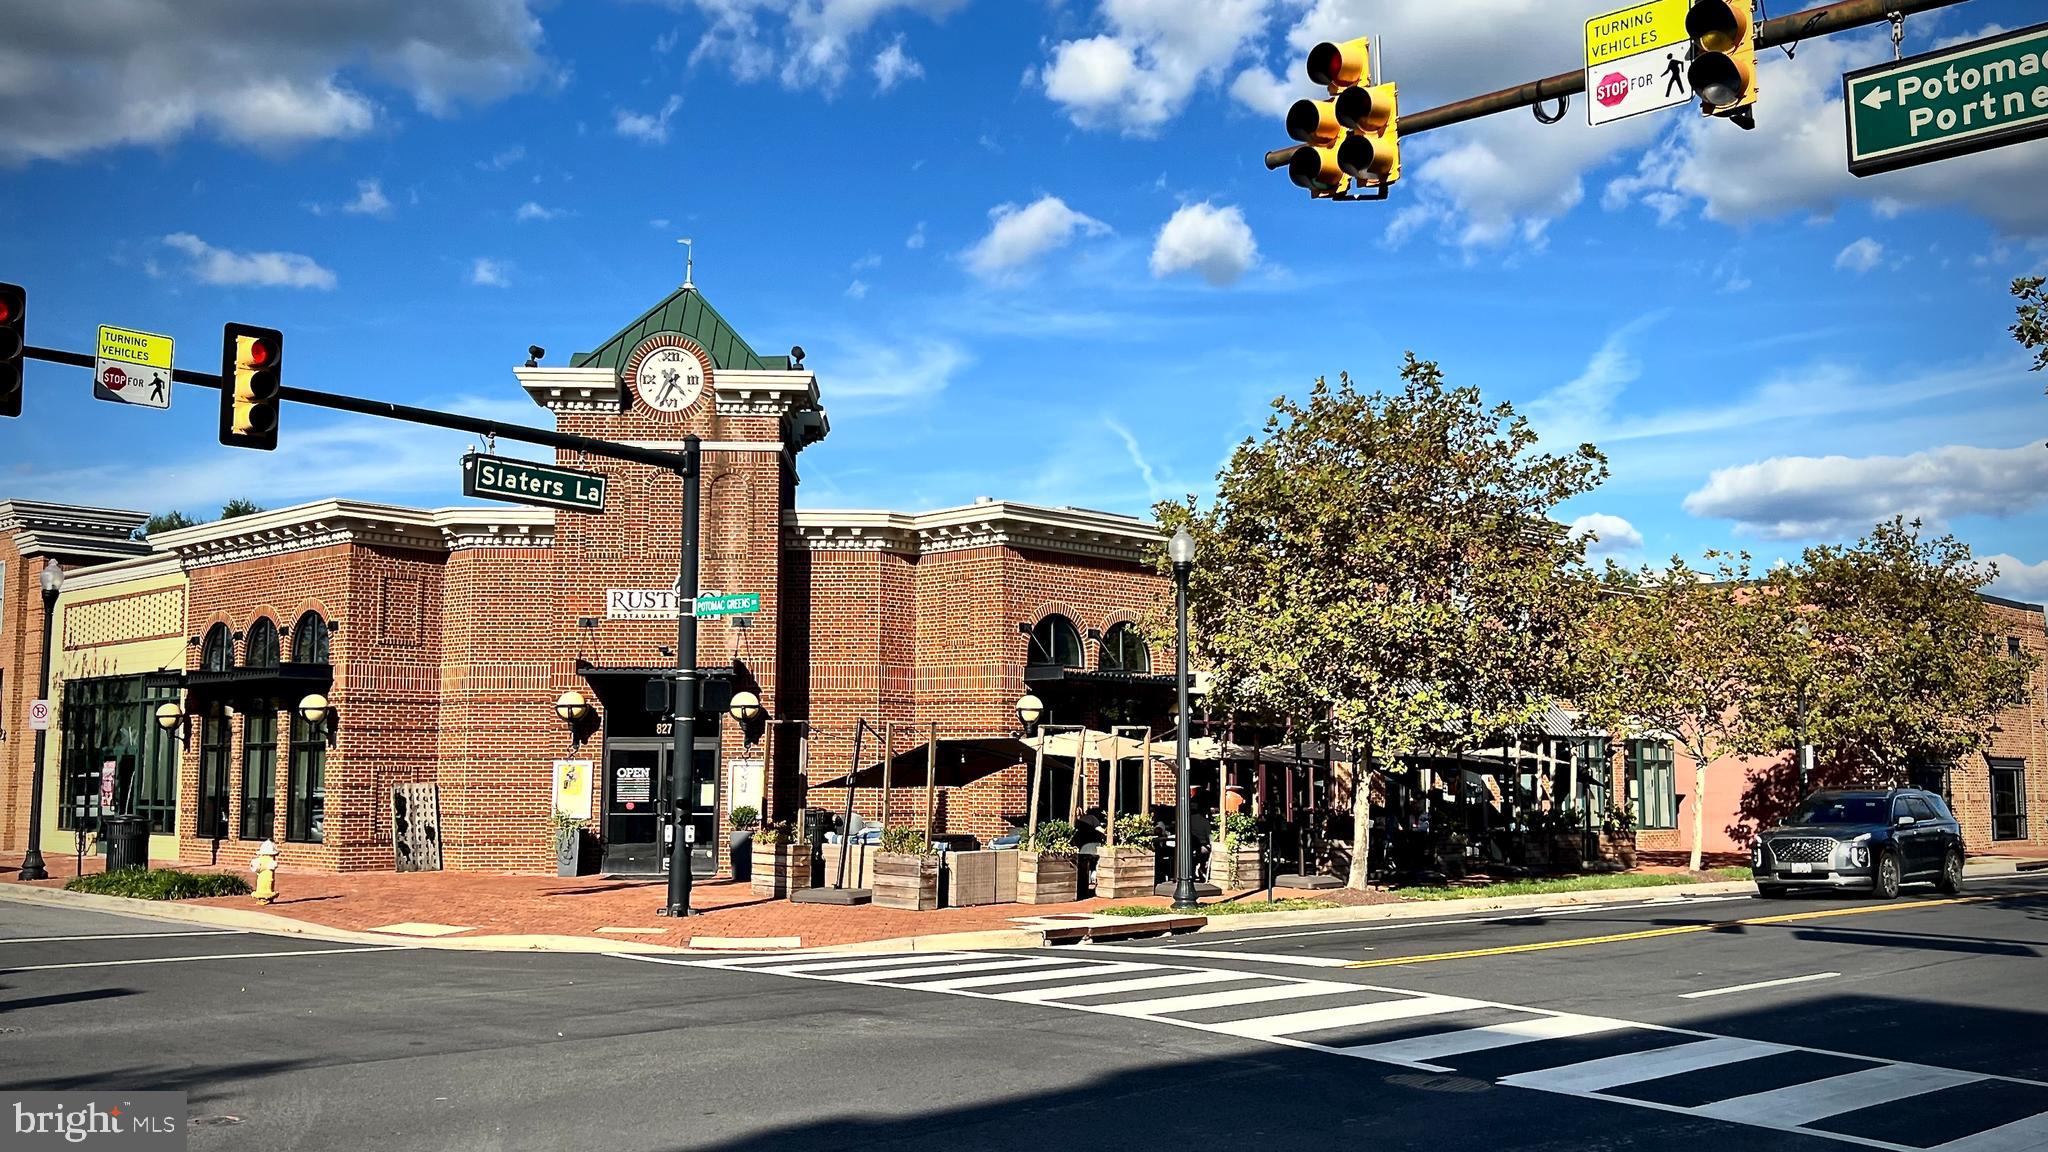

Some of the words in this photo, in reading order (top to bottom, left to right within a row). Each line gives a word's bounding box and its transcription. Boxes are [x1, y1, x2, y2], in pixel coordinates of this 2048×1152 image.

[1594, 12, 1653, 38] TURNING
[1592, 30, 1658, 57] VEHICLES
[1597, 80, 1628, 100] STOP
[1631, 74, 1653, 90] FOR
[105, 332, 147, 347] TURNING
[102, 345, 149, 360] VEHICLES
[104, 373, 126, 385] STOP
[128, 377, 144, 387] FOR
[481, 465, 564, 496] Slaters
[576, 481, 600, 502] La
[697, 600, 725, 612] POTOMAC
[727, 598, 750, 610] GREENS
[656, 723, 672, 734] 827
[617, 768, 650, 777] OPEN
